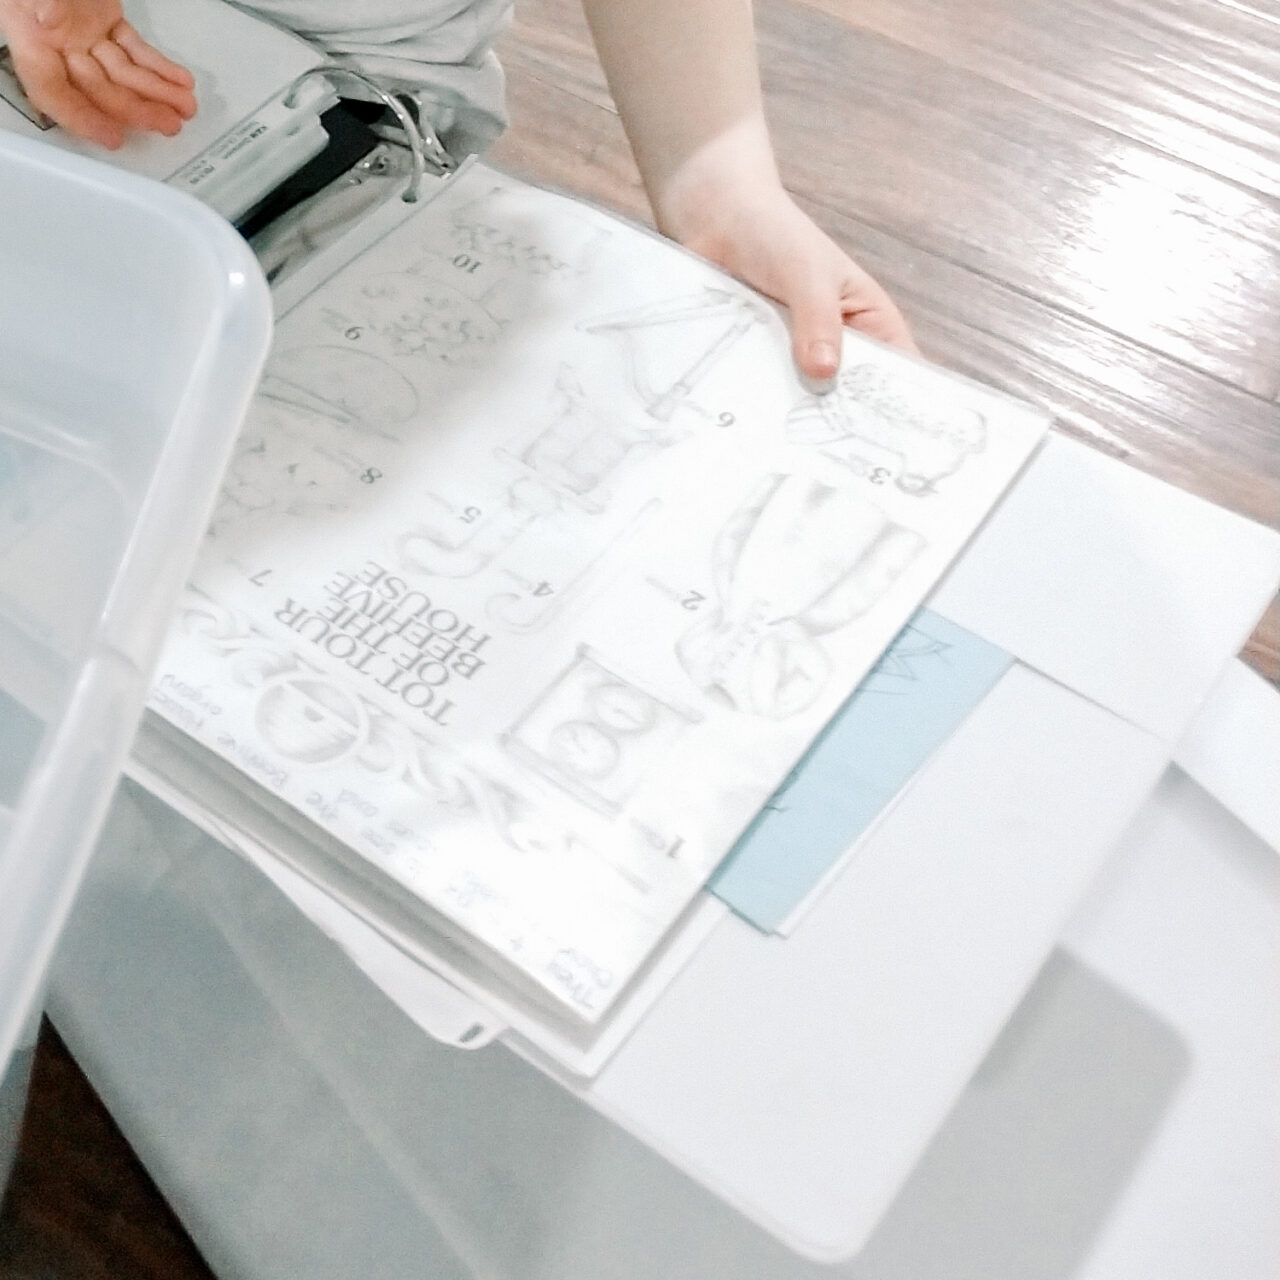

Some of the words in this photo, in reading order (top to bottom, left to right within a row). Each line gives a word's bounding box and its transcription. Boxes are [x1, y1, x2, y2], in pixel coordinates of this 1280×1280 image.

[452, 253, 483, 276] 10
[343, 323, 365, 342] 9
[359, 466, 384, 486] 8
[867, 466, 892, 487] 3
[458, 505, 482, 526] 5
[247, 567, 273, 588] 7
[530, 579, 556, 600] 4
[355, 560, 492, 654] HOUSE
[680, 588, 707, 613] 2
[271, 597, 378, 676] TOUR
[322, 571, 486, 680] BEEHIVE
[322, 598, 393, 655] THE
[390, 649, 451, 688] OF
[374, 664, 455, 726] TOT
[665, 835, 687, 862] 1
